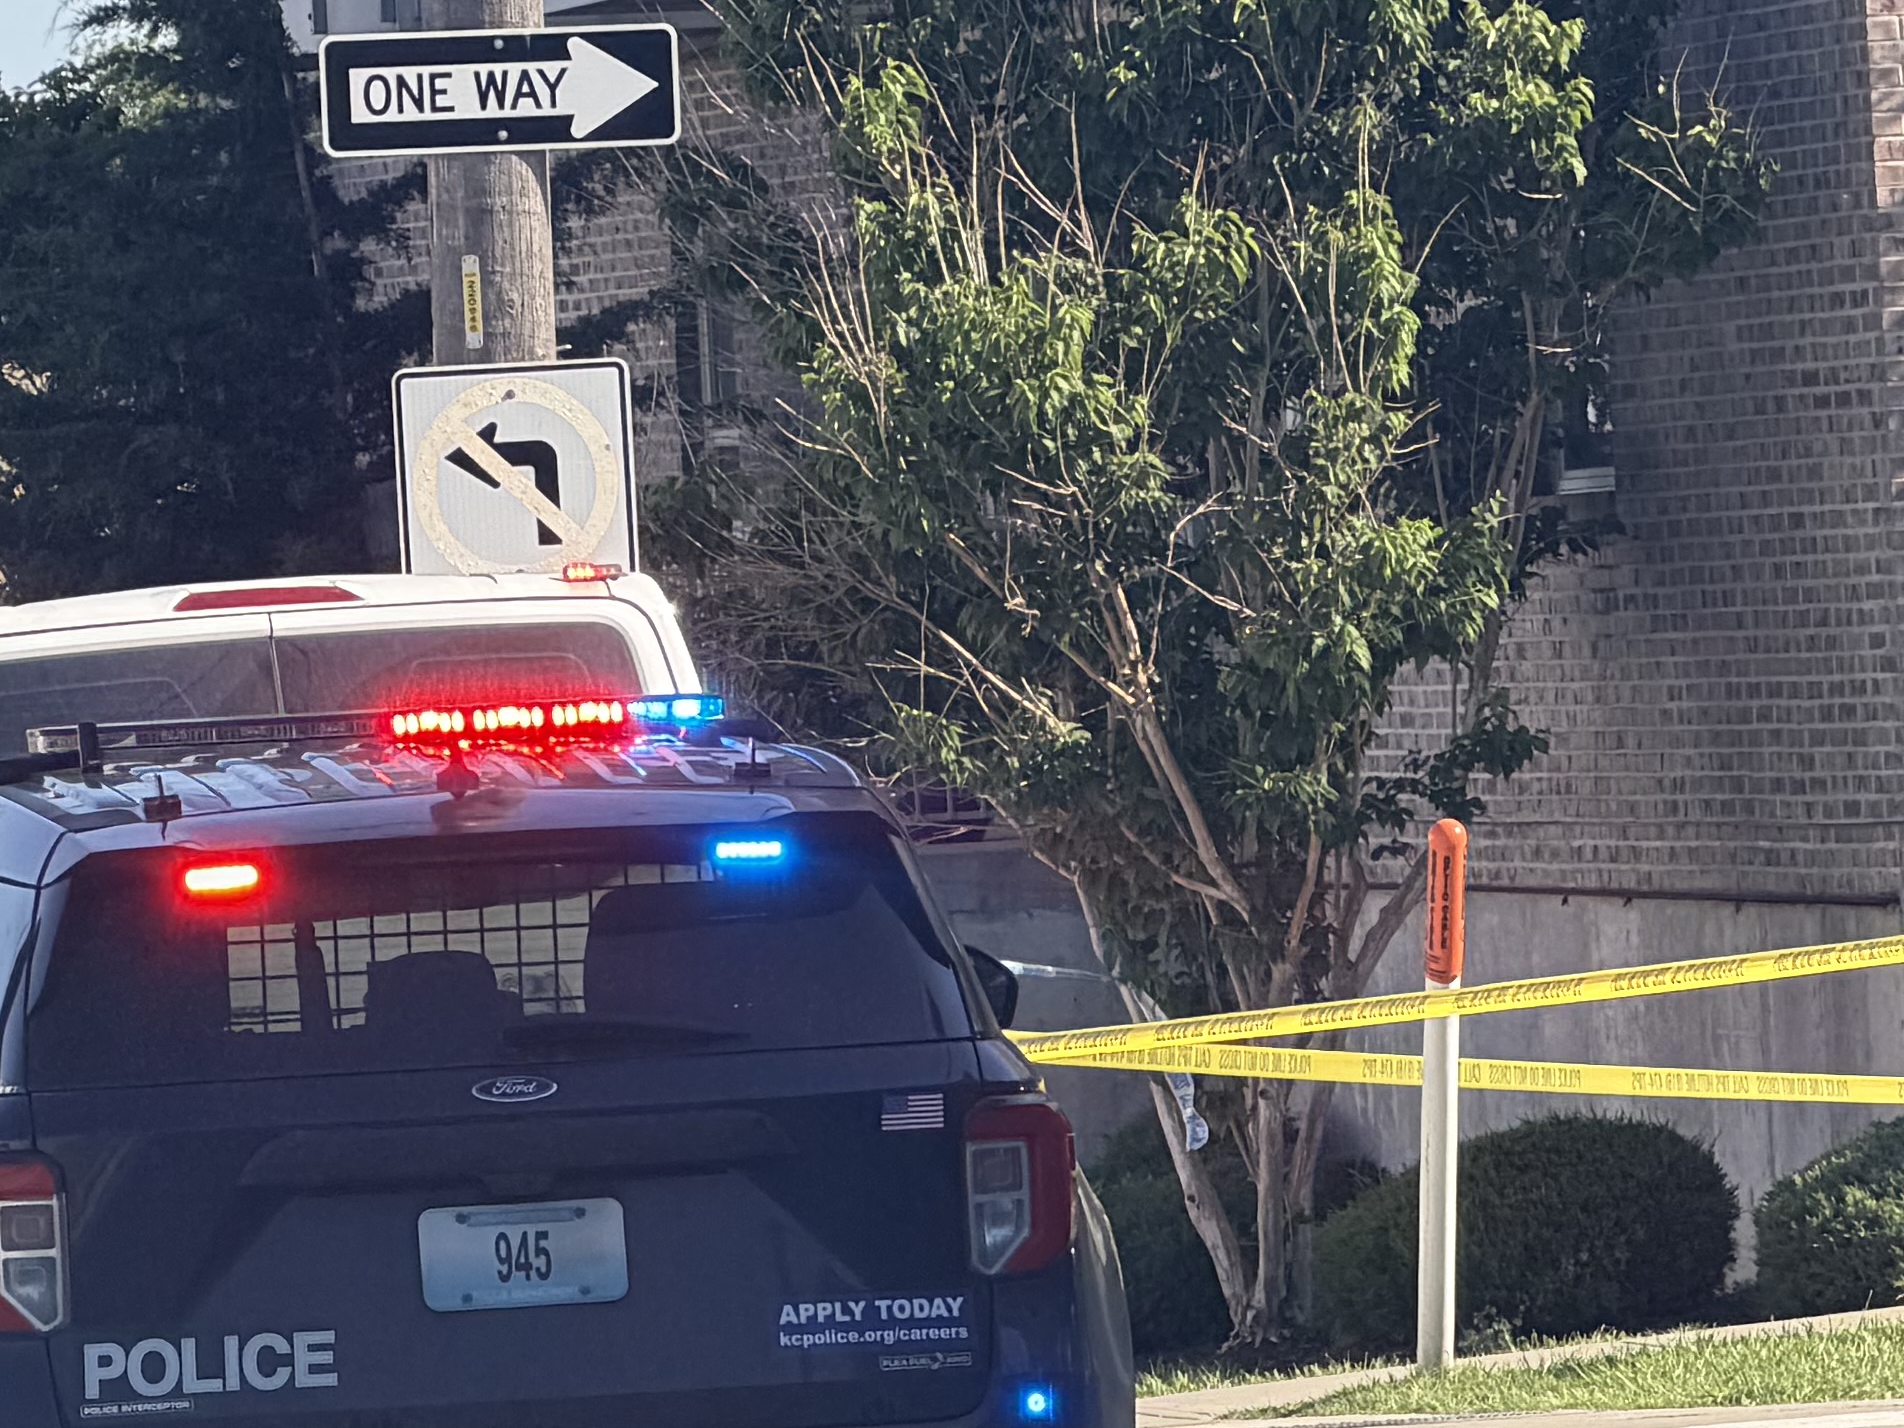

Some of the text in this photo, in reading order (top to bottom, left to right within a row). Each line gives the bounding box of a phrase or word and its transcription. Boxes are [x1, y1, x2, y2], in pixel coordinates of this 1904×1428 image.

[363, 66, 569, 117] ONE WAY
[491, 1077, 537, 1096] Ford
[494, 1230, 553, 1283] 945
[779, 1296, 964, 1325] APPLY TODAY
[779, 1325, 969, 1349] kcpolice.org/careers
[83, 1329, 339, 1400] POLICE
[83, 1401, 190, 1415] POLICE INTERCEPTOR
